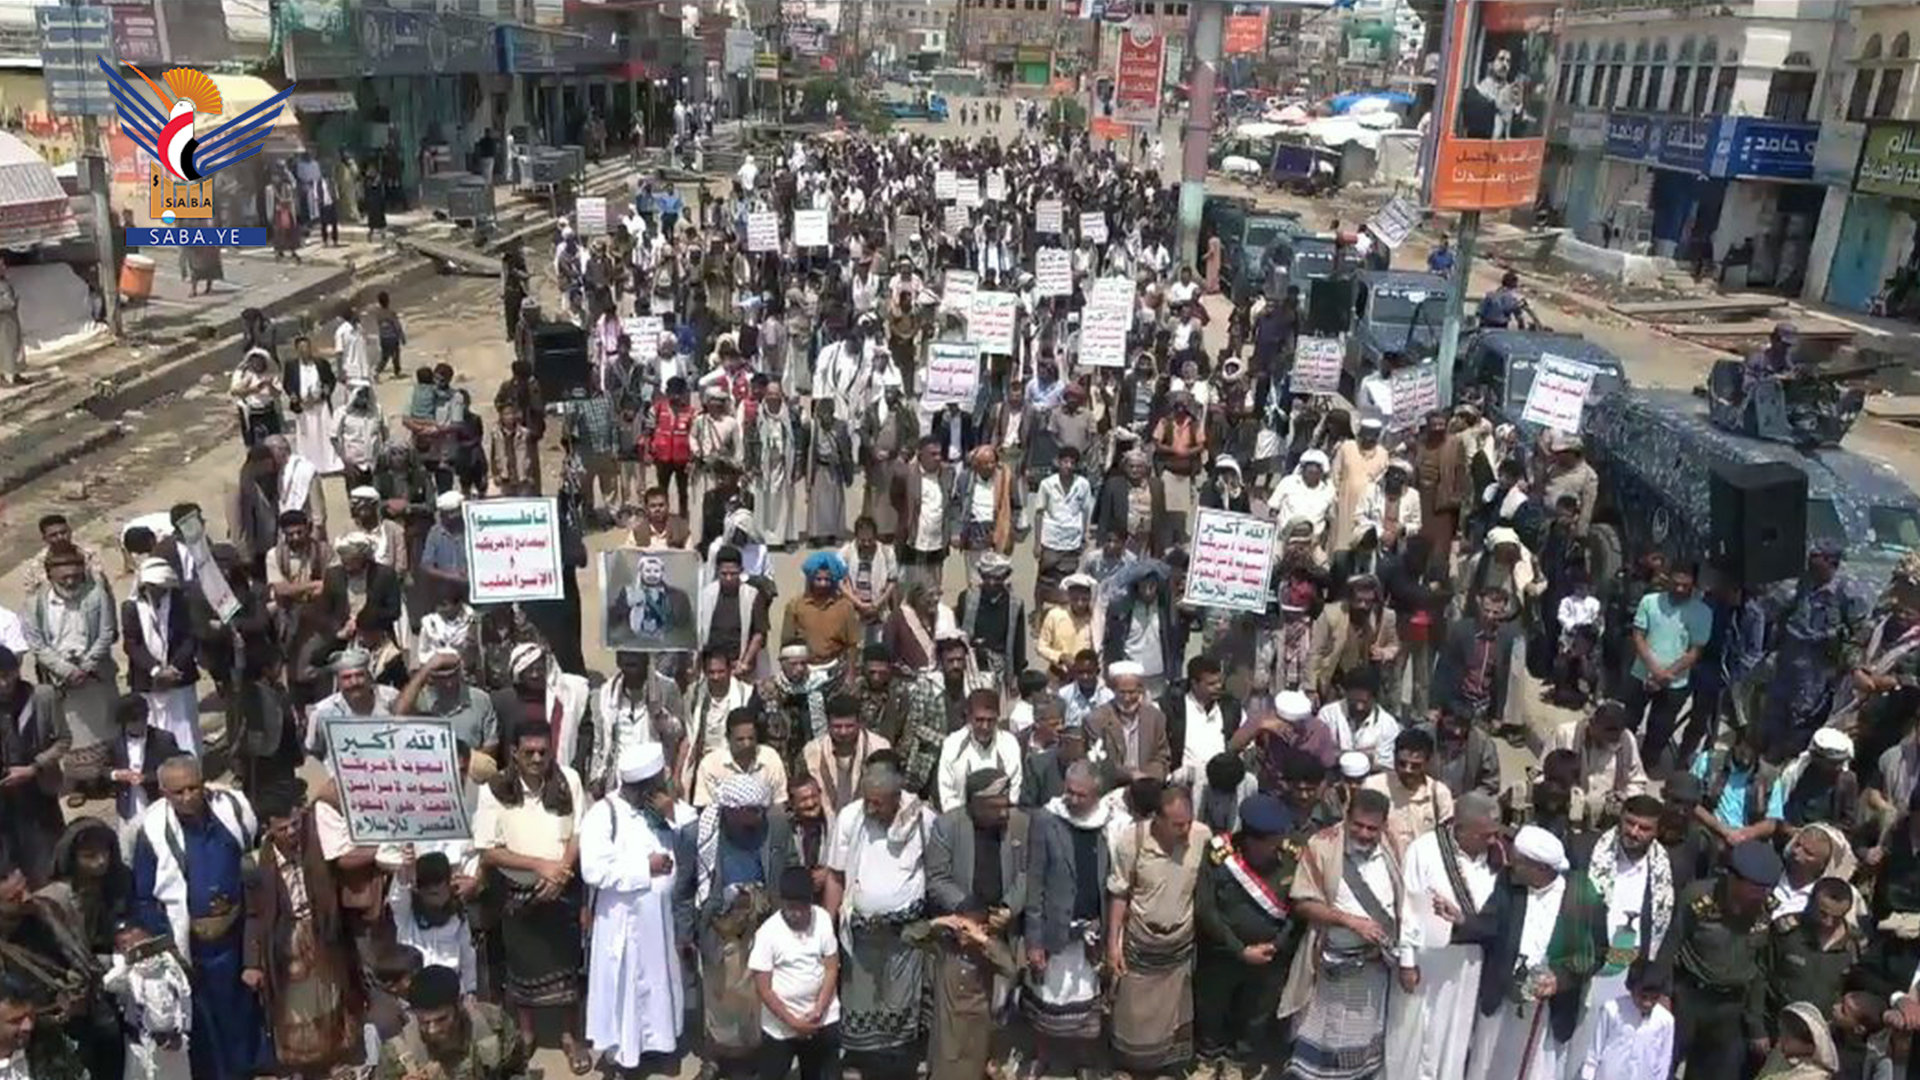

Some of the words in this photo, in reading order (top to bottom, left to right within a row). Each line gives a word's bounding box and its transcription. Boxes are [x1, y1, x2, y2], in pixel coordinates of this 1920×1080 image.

[1245, 523, 1272, 539] الله
[339, 725, 400, 756] أكبر
[405, 728, 447, 750] الله
[401, 760, 449, 776] الموت
[406, 781, 453, 796] الموت
[415, 816, 463, 836] النصر
